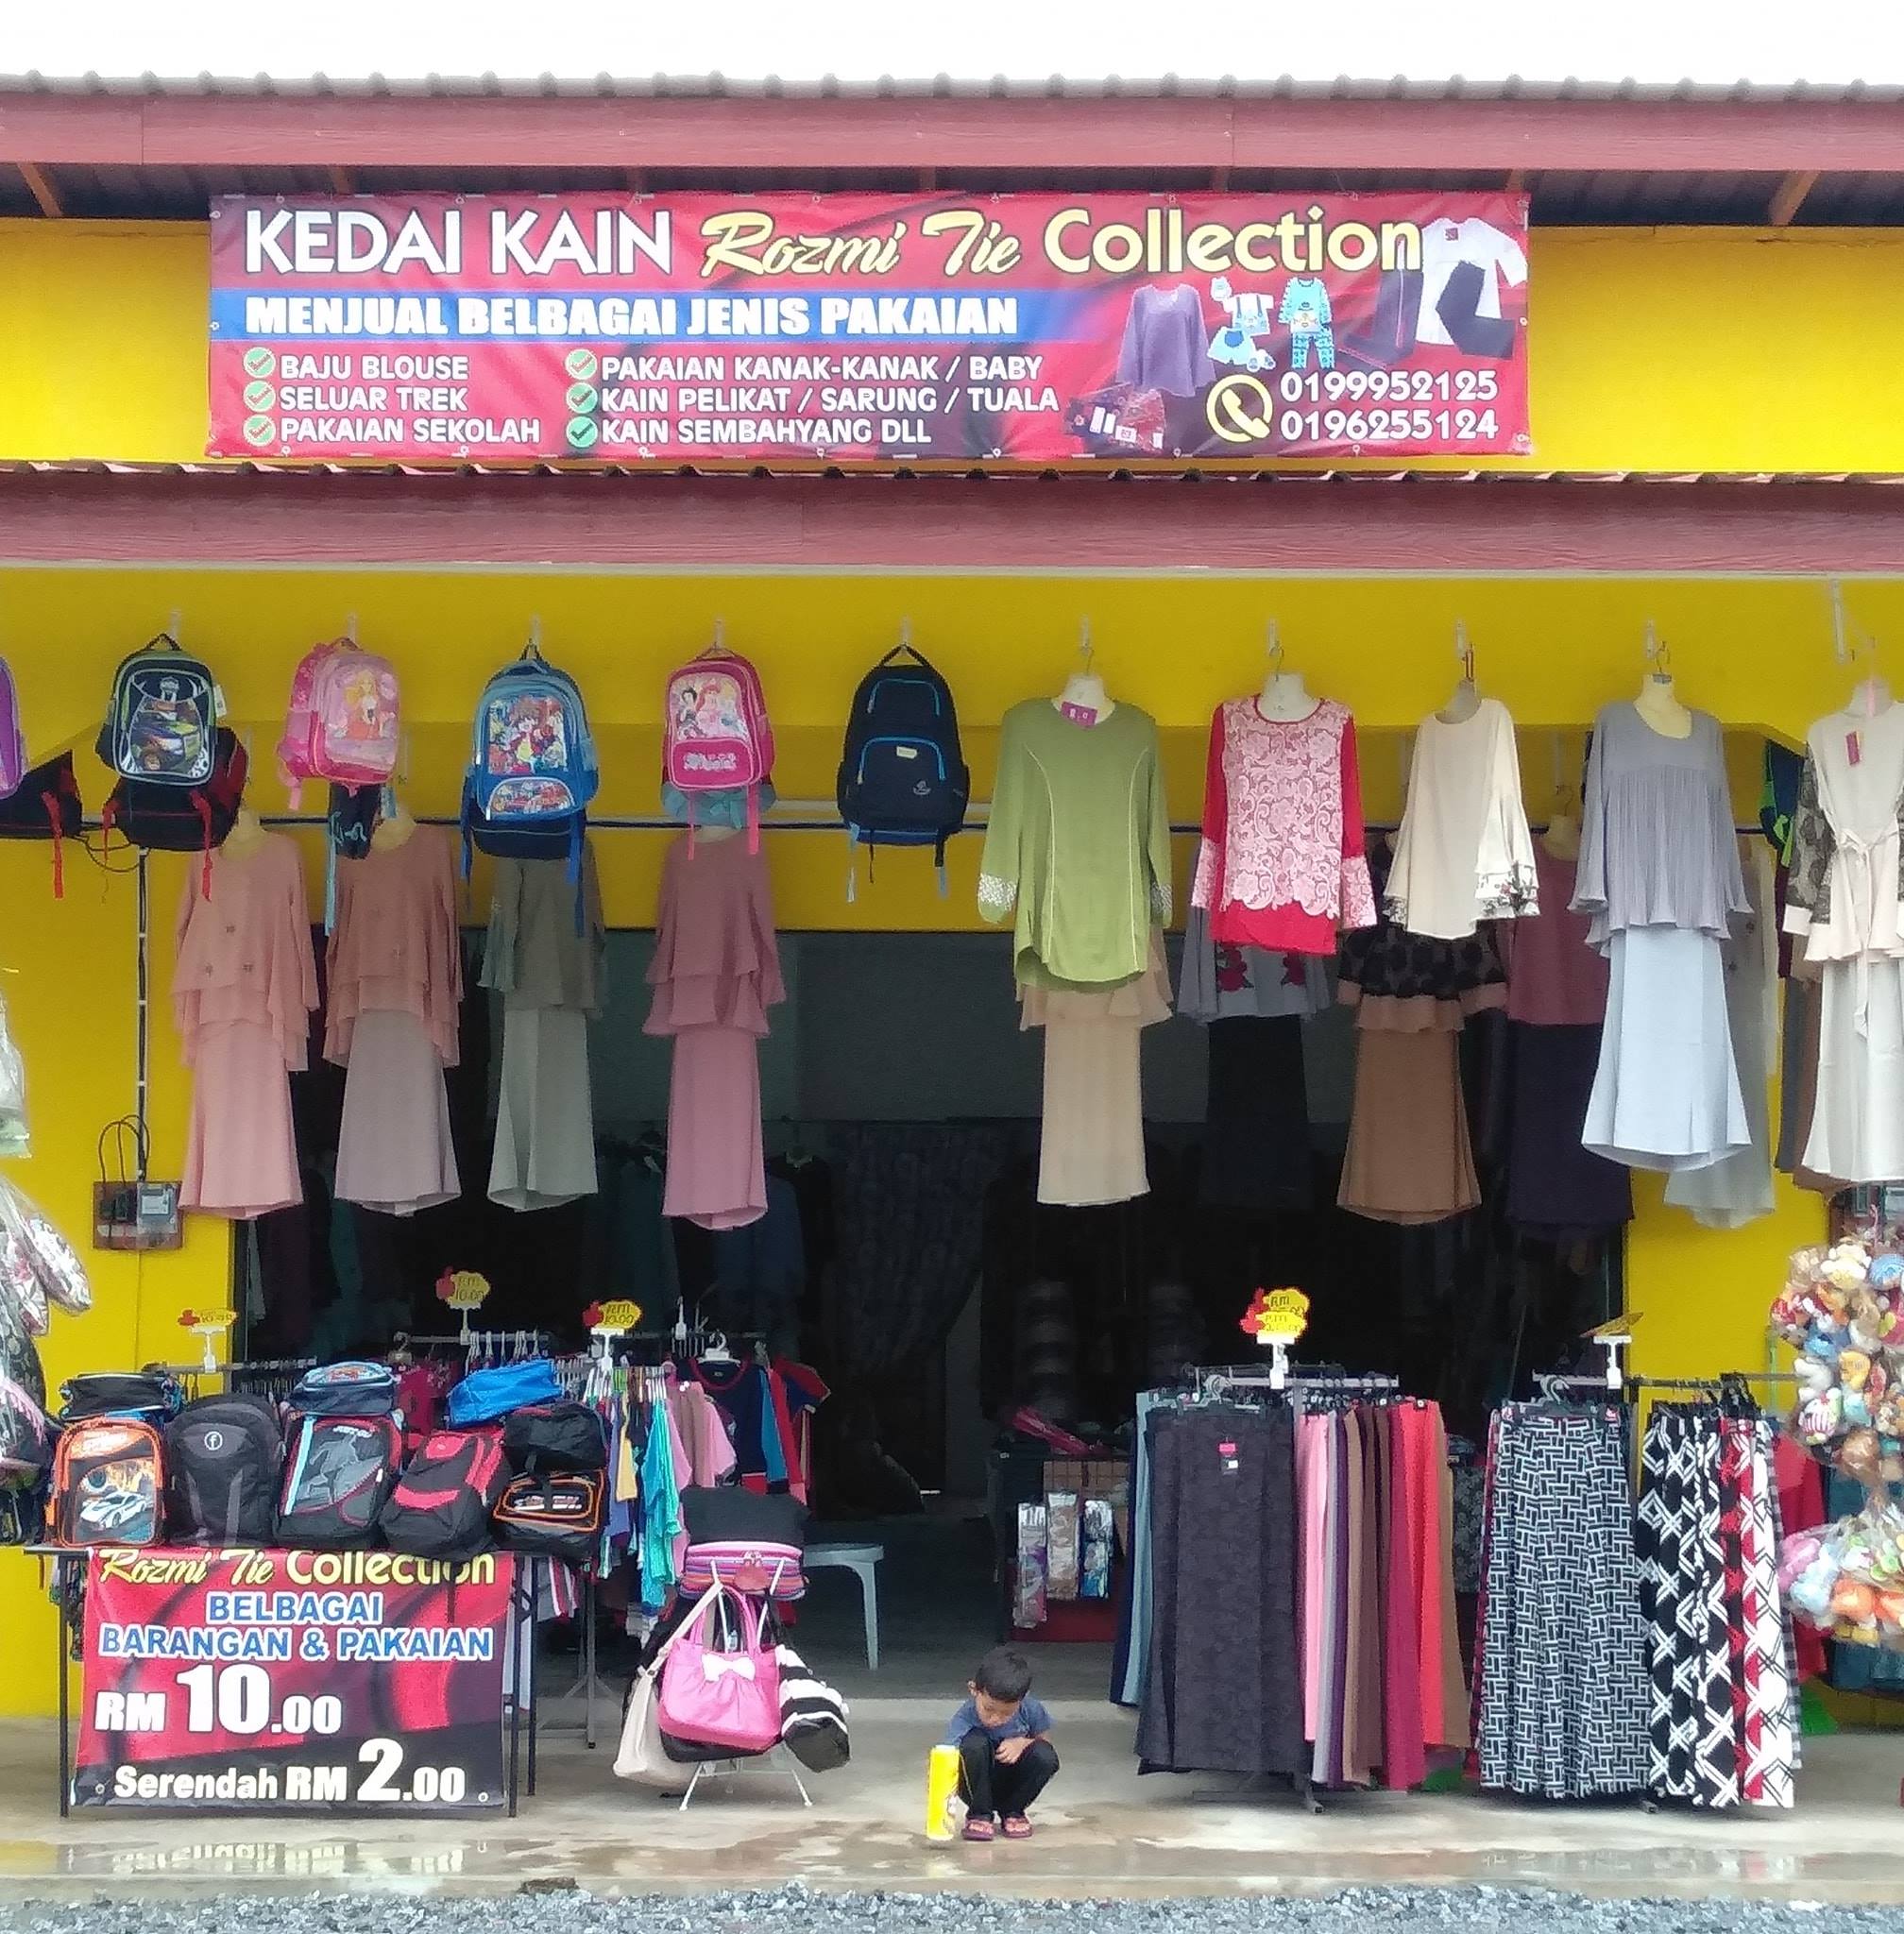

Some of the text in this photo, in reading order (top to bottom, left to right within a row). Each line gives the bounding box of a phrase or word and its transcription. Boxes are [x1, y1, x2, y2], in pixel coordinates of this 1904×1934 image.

[246, 205, 1423, 278] KEDAI KAIN Rozmi Tie Collection
[245, 297, 1018, 336] MENJUAL BELBAGAI JENIS PAKAIAN
[280, 355, 469, 380] BAJU BLOUSE
[601, 356, 1044, 382] PAKAIAN KANAK-KANAK / BABY
[280, 386, 468, 412] SELUAR TREK
[602, 386, 1059, 415] KAIN PELIKAT / SARUNG / TUALA
[1280, 370, 1499, 402] 0199952125
[280, 417, 540, 444] PAKAIAN SEKOLAH
[602, 418, 933, 444] KAIN SEMBAHYANG DLL
[1280, 410, 1499, 441] 0196255124
[99, 1548, 209, 1585] Rozmi
[219, 1548, 275, 1586] Tie
[207, 1592, 382, 1624] BELBAGAI
[99, 1624, 493, 1661] BARANGAN & PAKAIAN
[94, 1663, 342, 1735] RM 10.00
[114, 1738, 466, 1803] Serendah RM 2.00
